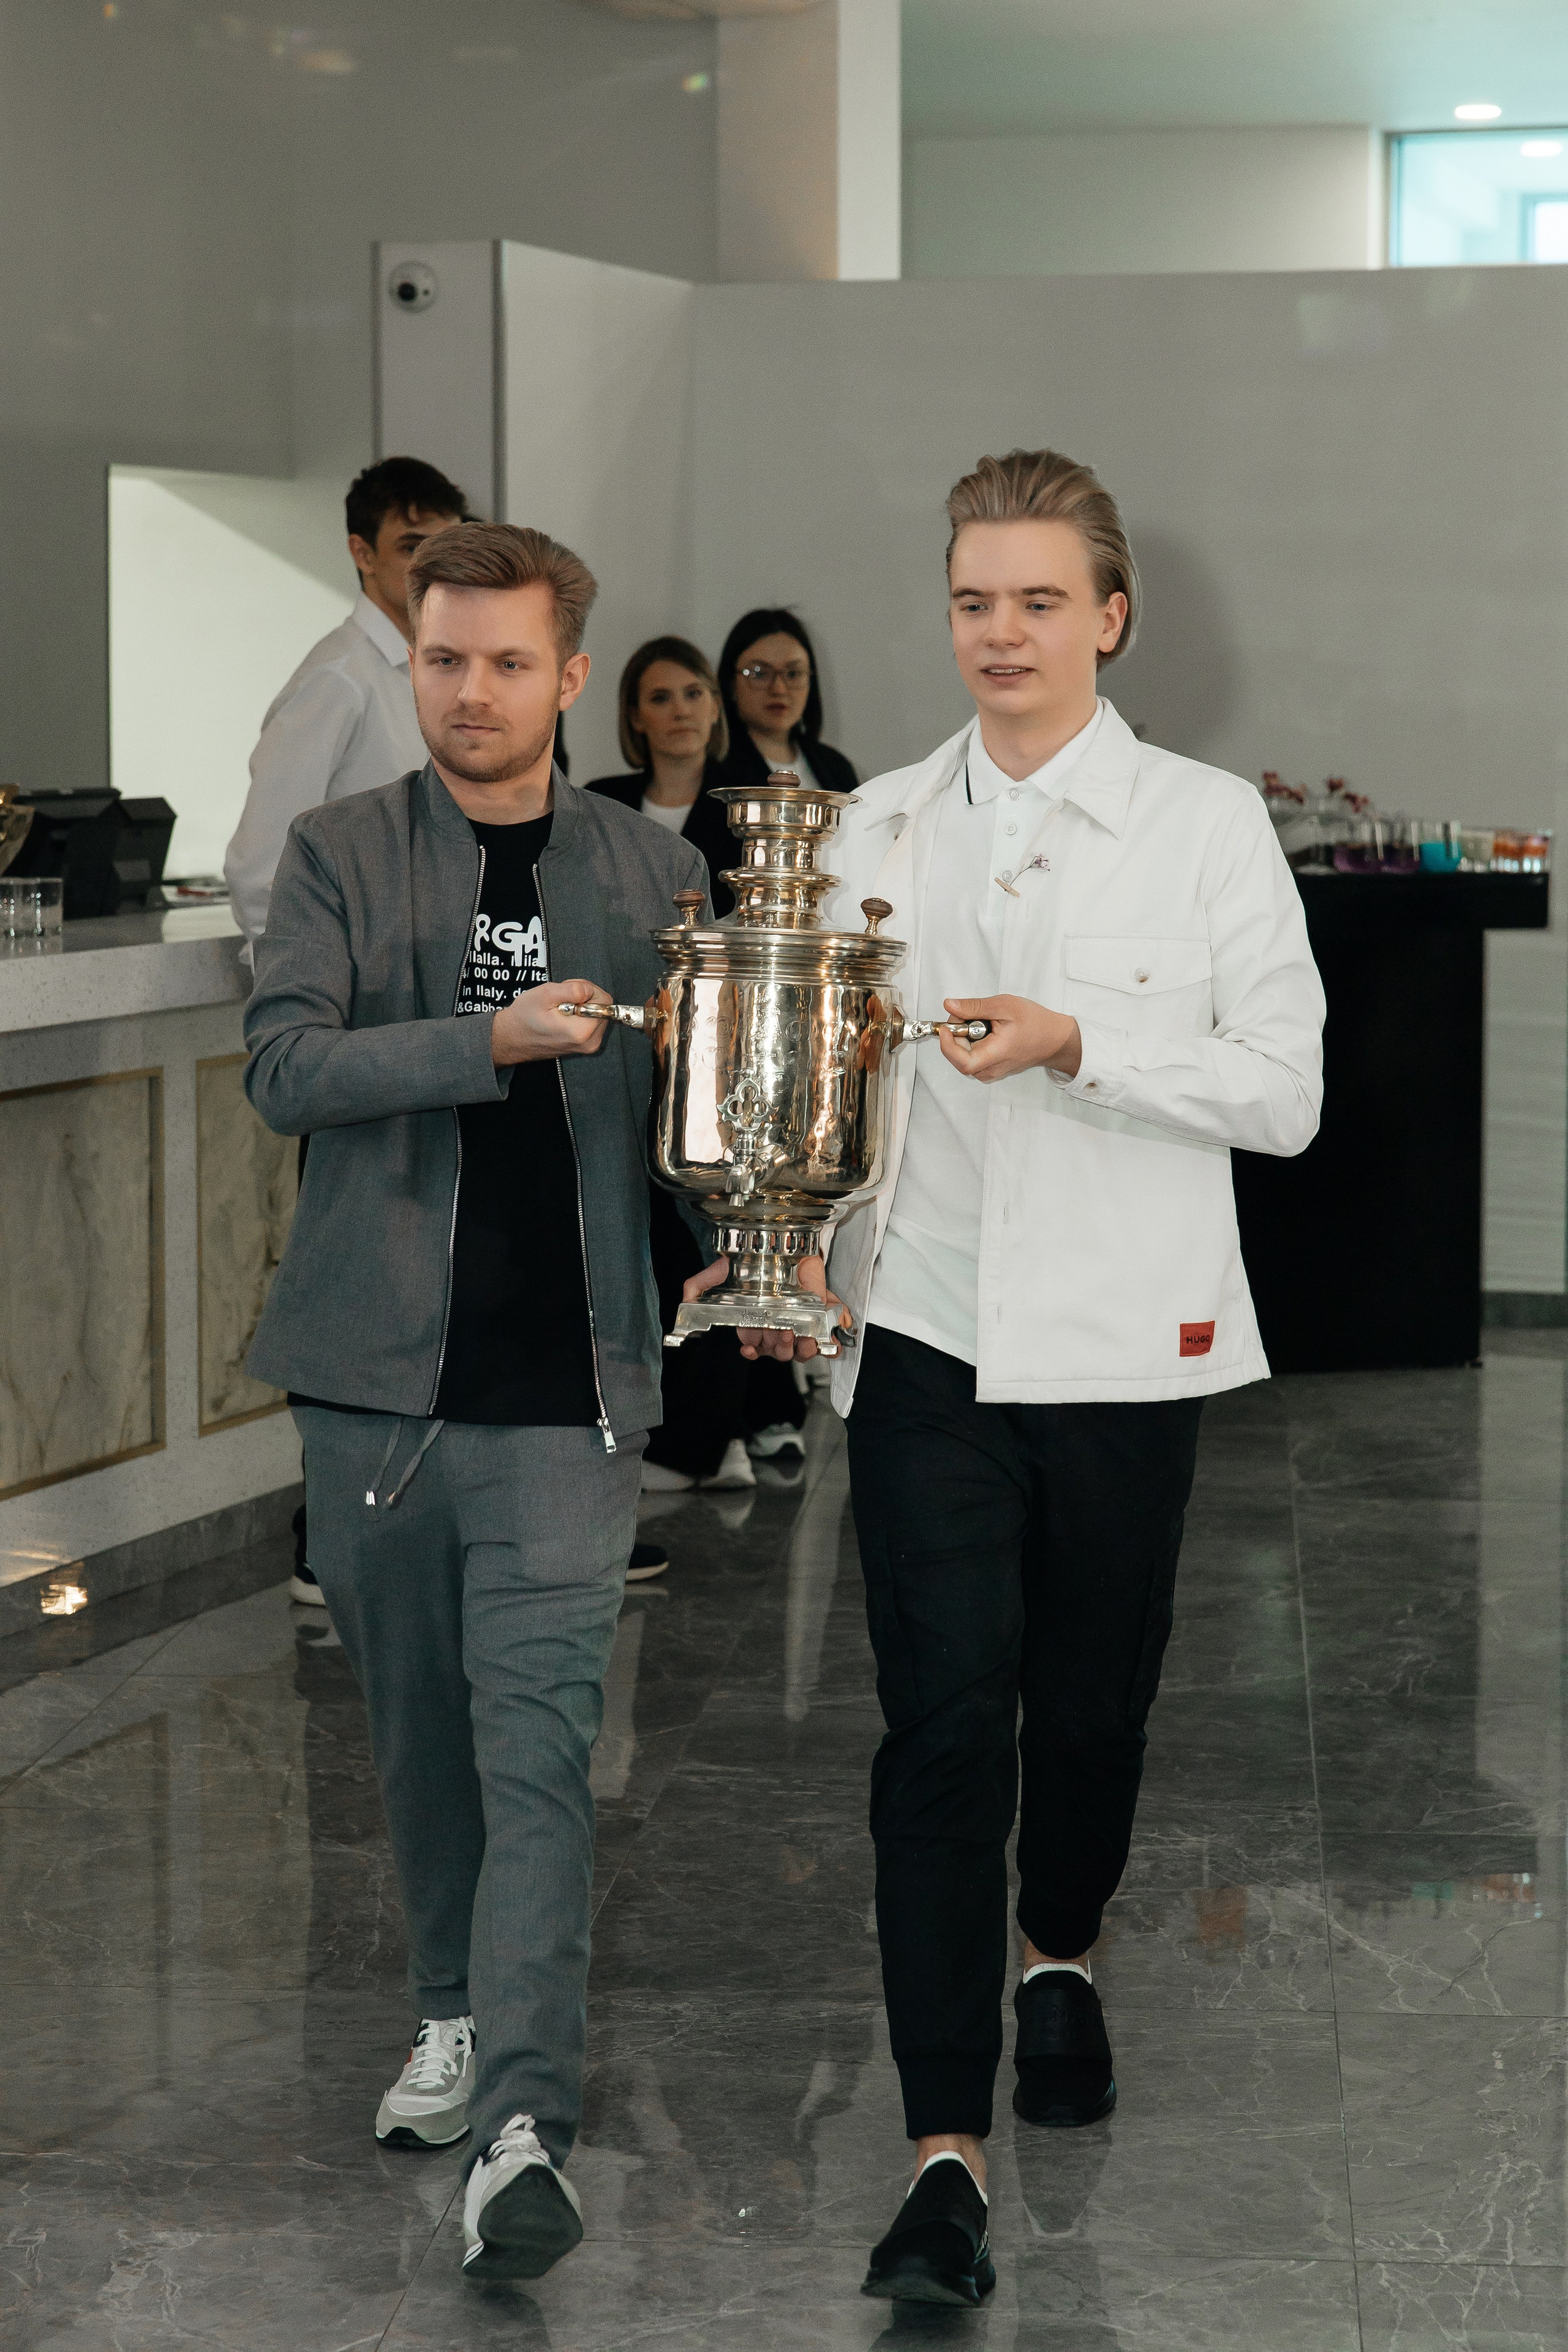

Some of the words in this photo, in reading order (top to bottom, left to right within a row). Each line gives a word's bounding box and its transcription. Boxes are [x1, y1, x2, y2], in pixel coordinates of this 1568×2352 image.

[492, 969, 510, 981] 00
[462, 986, 472, 997] in
[1186, 1335, 1210, 1344] HUGO
